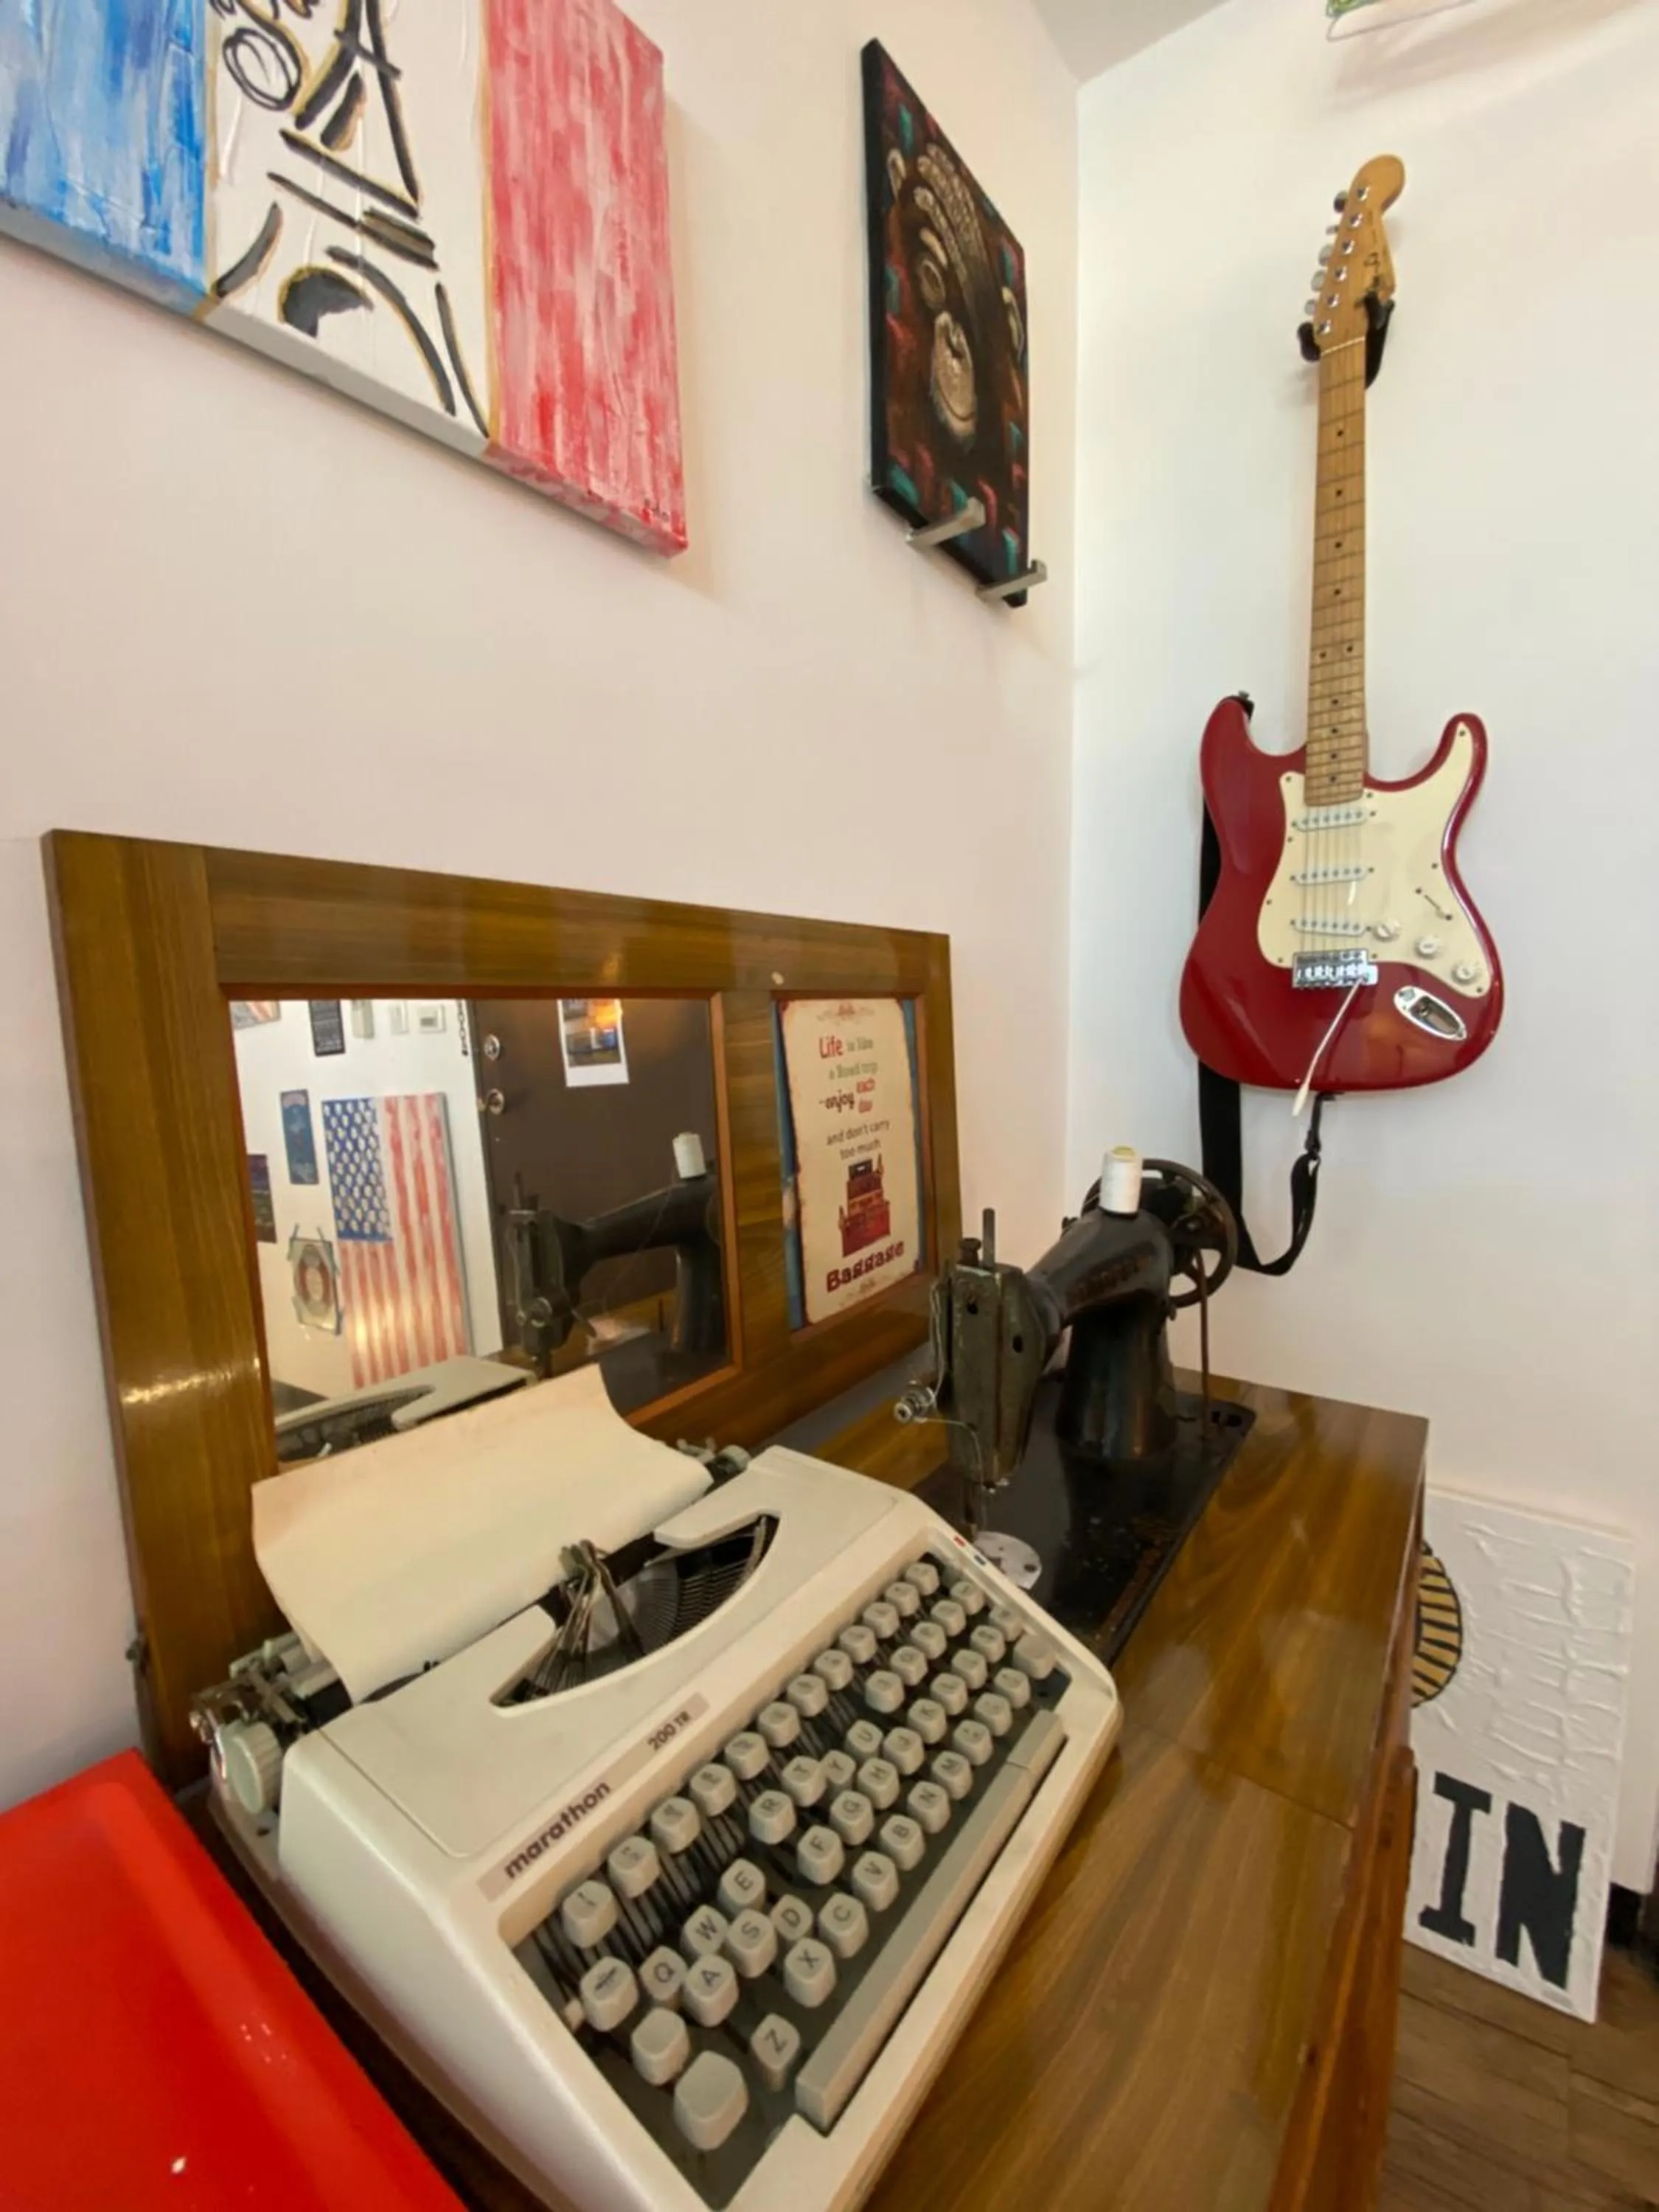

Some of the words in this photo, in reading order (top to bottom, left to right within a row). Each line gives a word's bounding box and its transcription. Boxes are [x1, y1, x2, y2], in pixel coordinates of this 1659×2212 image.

[819, 1034, 844, 1059] Life
[826, 1130, 844, 1147] and
[869, 1119, 890, 1134] carry
[856, 1138, 881, 1155] much
[826, 1241, 905, 1293] Baggage
[504, 1781, 611, 1879] marathon
[647, 1722, 677, 1752] 200
[1418, 1770, 1586, 1992] IN
[653, 1962, 675, 1983] Q
[695, 1915, 717, 1941] W
[734, 1870, 754, 1891] E
[701, 1969, 722, 1987] A
[740, 1921, 760, 1939] S
[781, 1908, 801, 1928] D
[764, 2028, 788, 2054] Z
[798, 1950, 820, 1969] X
[833, 1905, 852, 1922] C
[891, 1824, 910, 1839] B
